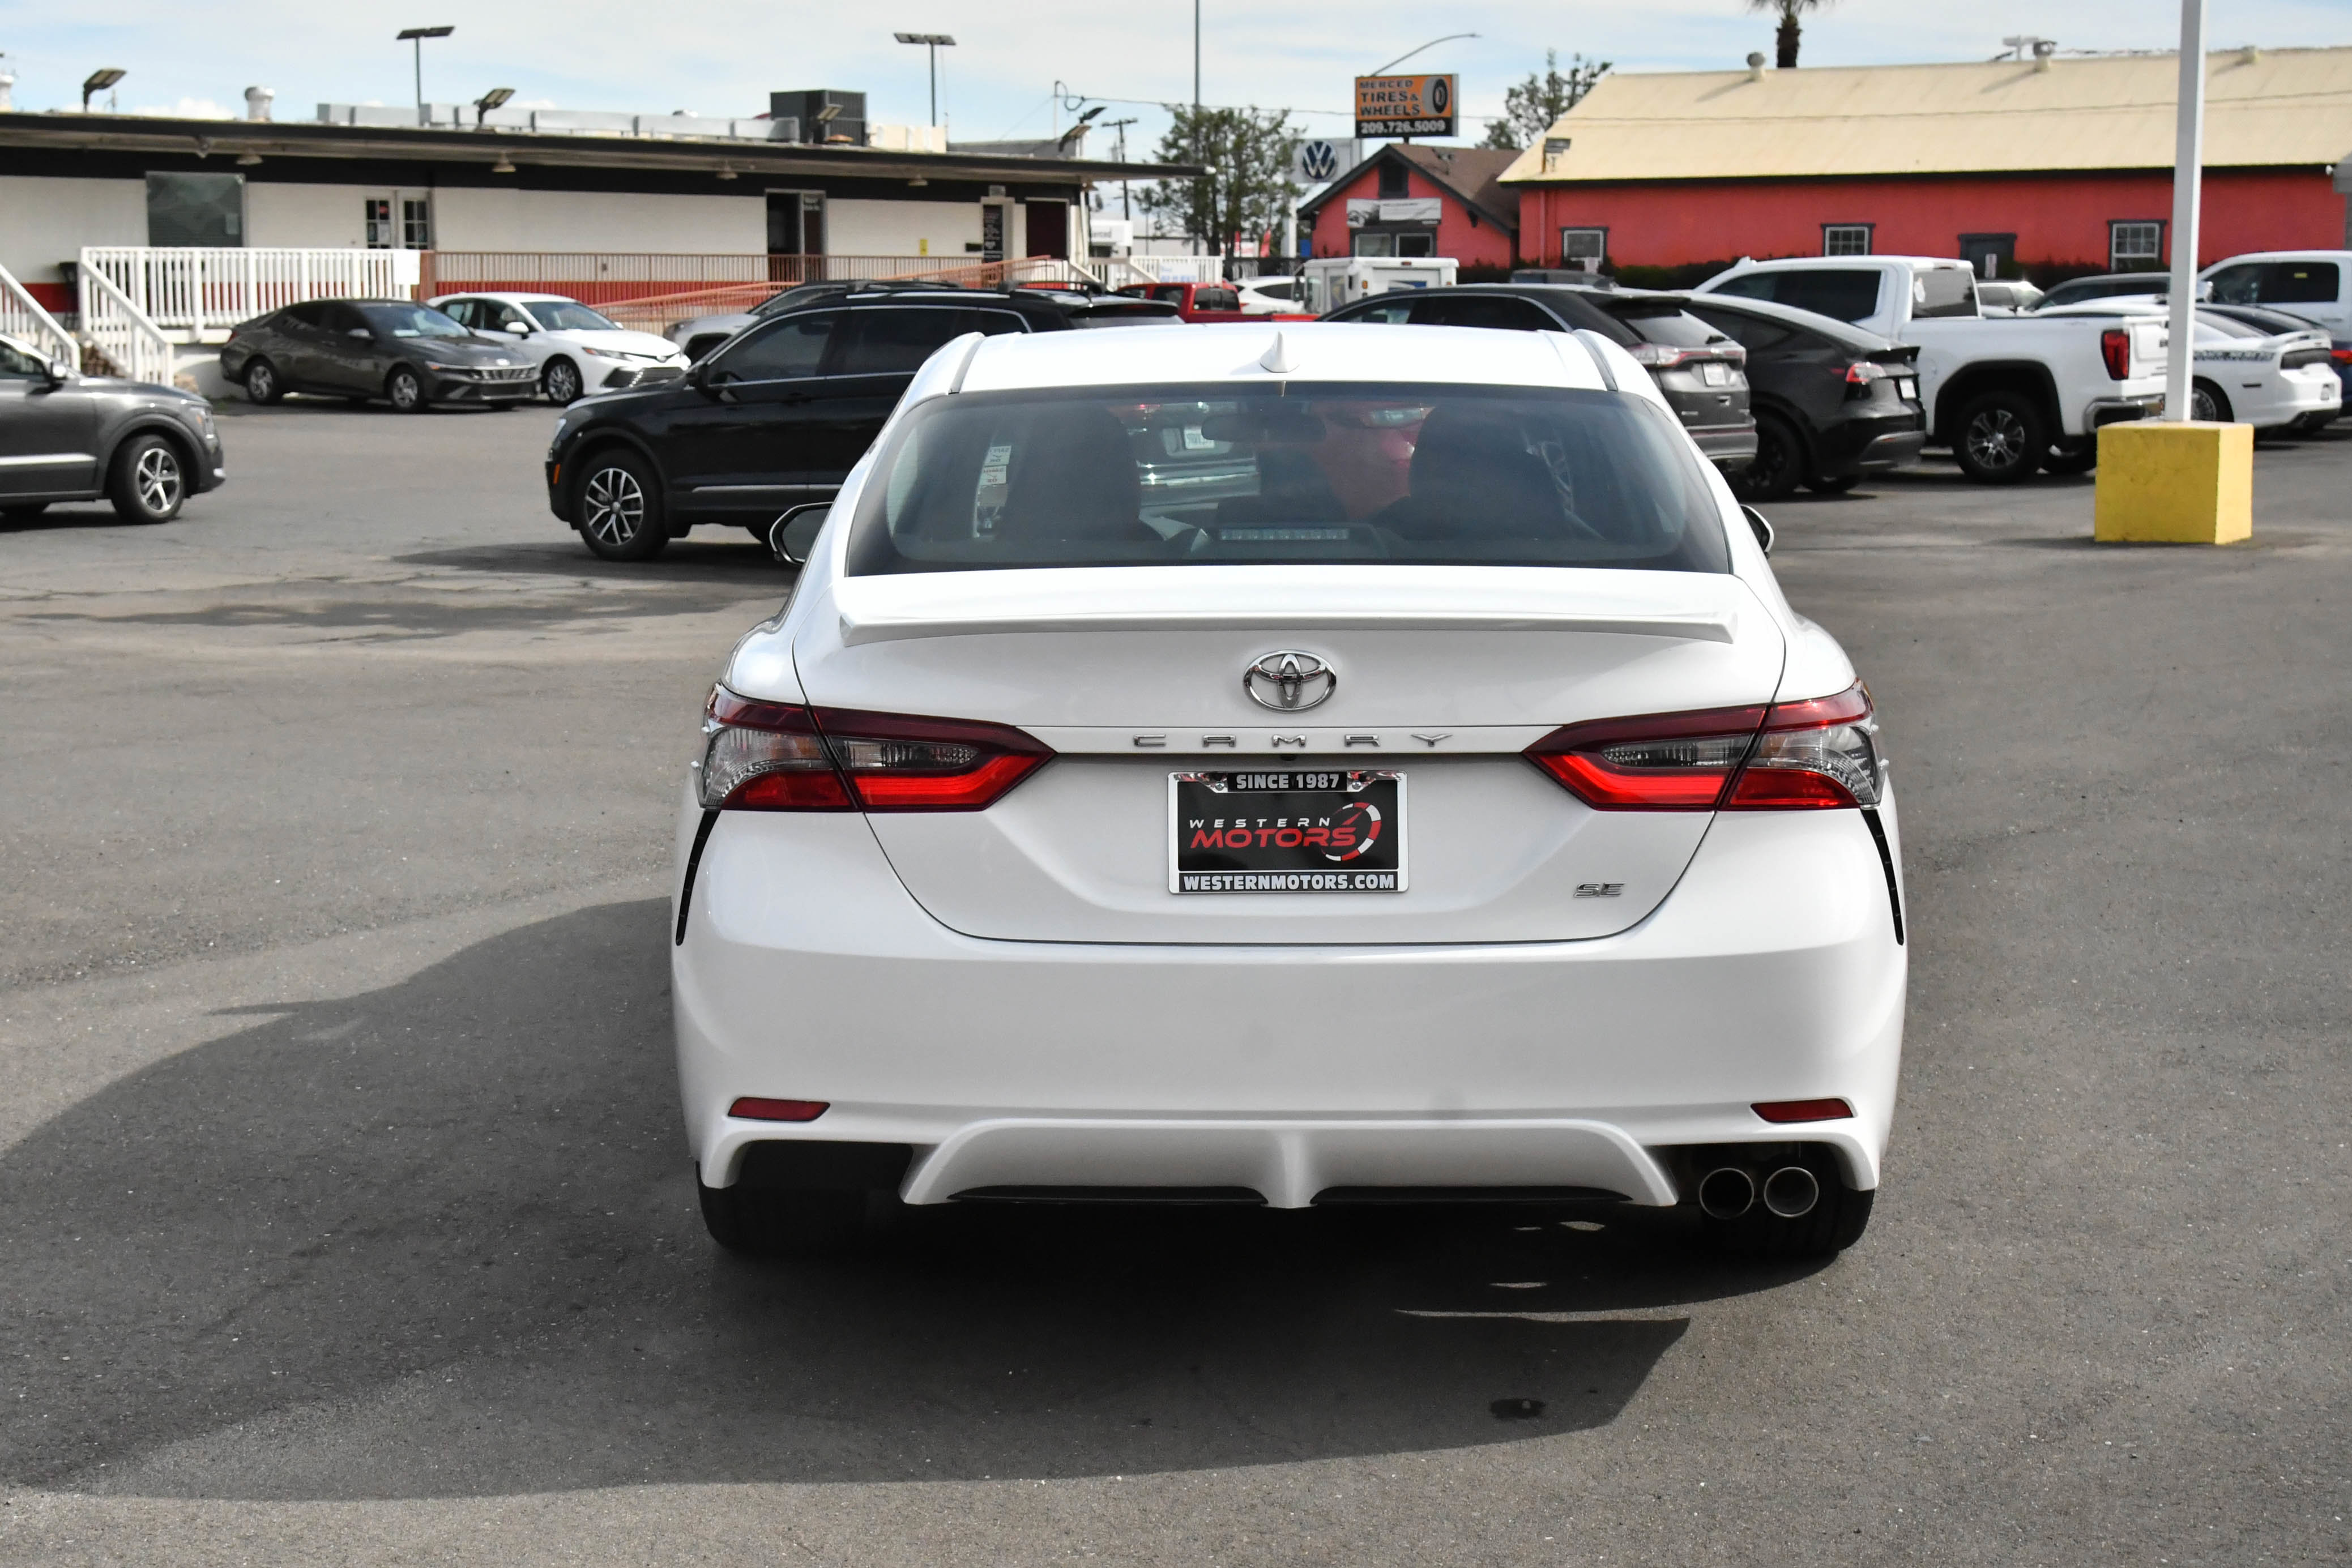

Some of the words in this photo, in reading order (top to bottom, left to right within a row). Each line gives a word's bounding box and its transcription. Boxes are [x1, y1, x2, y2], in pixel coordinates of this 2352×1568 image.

[1360, 80, 1412, 88] MERCED
[1360, 91, 1408, 102] TIRES
[1360, 104, 1420, 116] WHEELS
[1361, 121, 1445, 134] 209.726.5009
[1133, 733, 1453, 748] CAMRY
[1236, 775, 1289, 789] SINCE
[1296, 774, 1339, 789] 1987
[1189, 817, 1330, 828] WESTERN
[1190, 827, 1356, 848] MOTORS
[1184, 874, 1394, 890] WESTERNMOTORS.COM
[1573, 882, 1627, 898] SE
